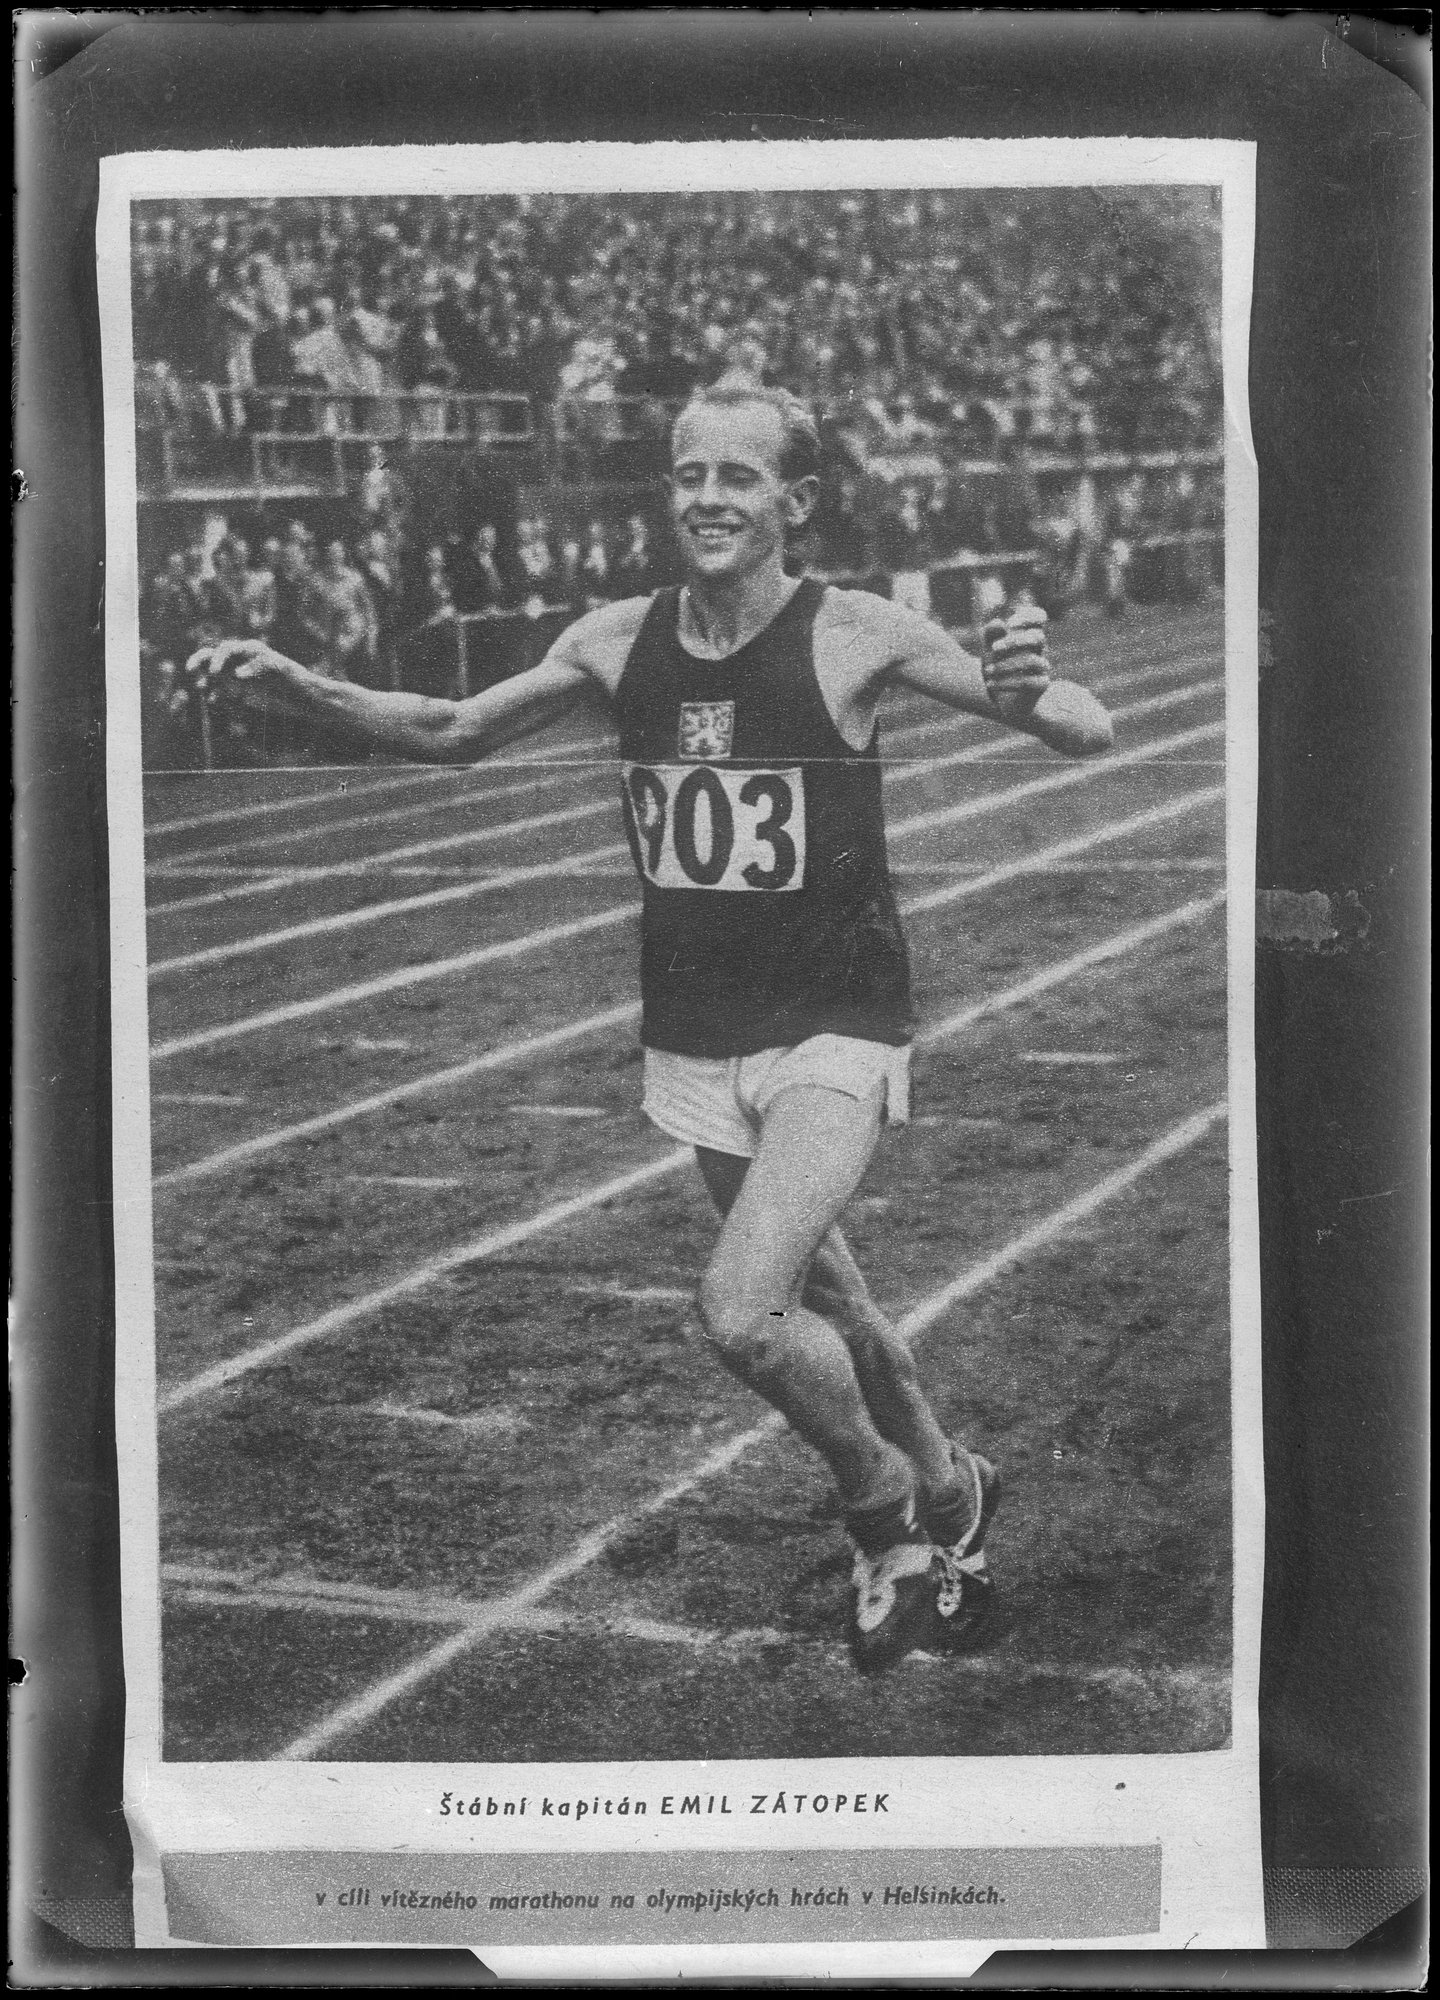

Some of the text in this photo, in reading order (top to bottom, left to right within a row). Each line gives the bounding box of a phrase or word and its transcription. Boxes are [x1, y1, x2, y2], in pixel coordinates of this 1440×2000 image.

[439, 1790, 890, 1821] Štábní kapitán EMIL ZÁTOPEK
[315, 1885, 1007, 1913] v cíli vítězného marathonu na olympijských hrách v Helsinkách.
